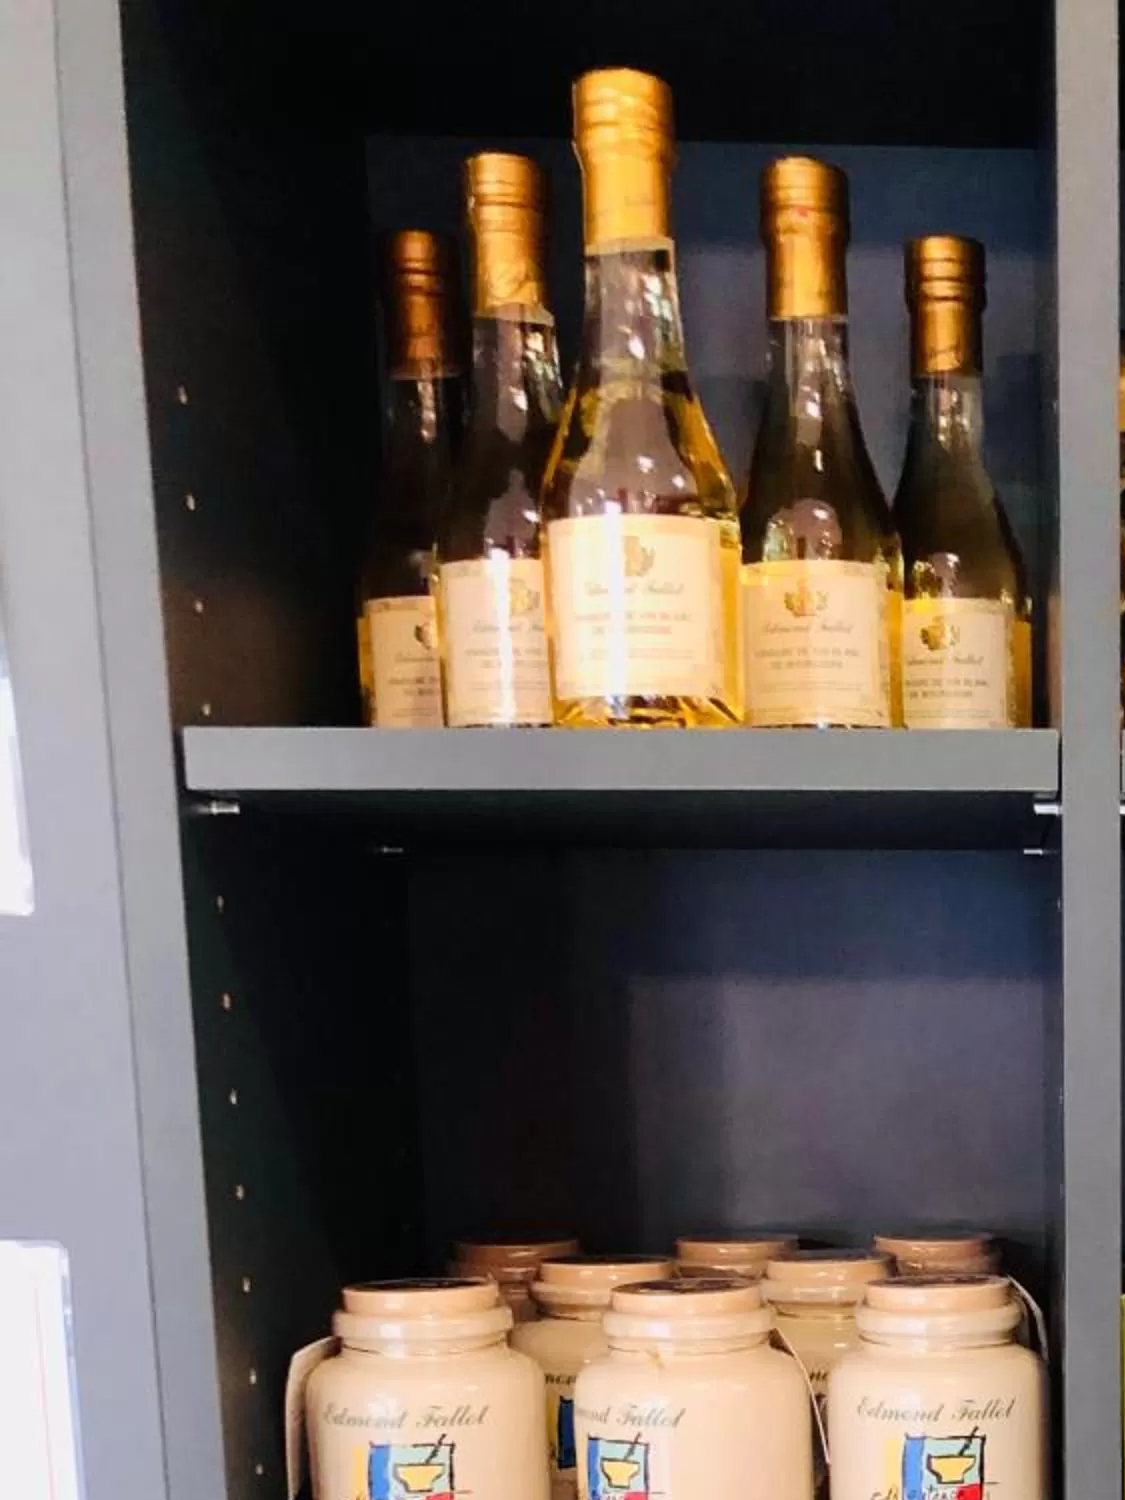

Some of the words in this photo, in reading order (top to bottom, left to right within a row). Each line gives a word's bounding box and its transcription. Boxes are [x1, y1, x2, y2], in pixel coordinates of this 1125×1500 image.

[322, 1401, 408, 1429] Edmond
[416, 1403, 490, 1429] Fallot
[616, 1403, 687, 1429] Fallot
[857, 1395, 945, 1423] Edmond
[952, 1396, 1017, 1423] Fallot
